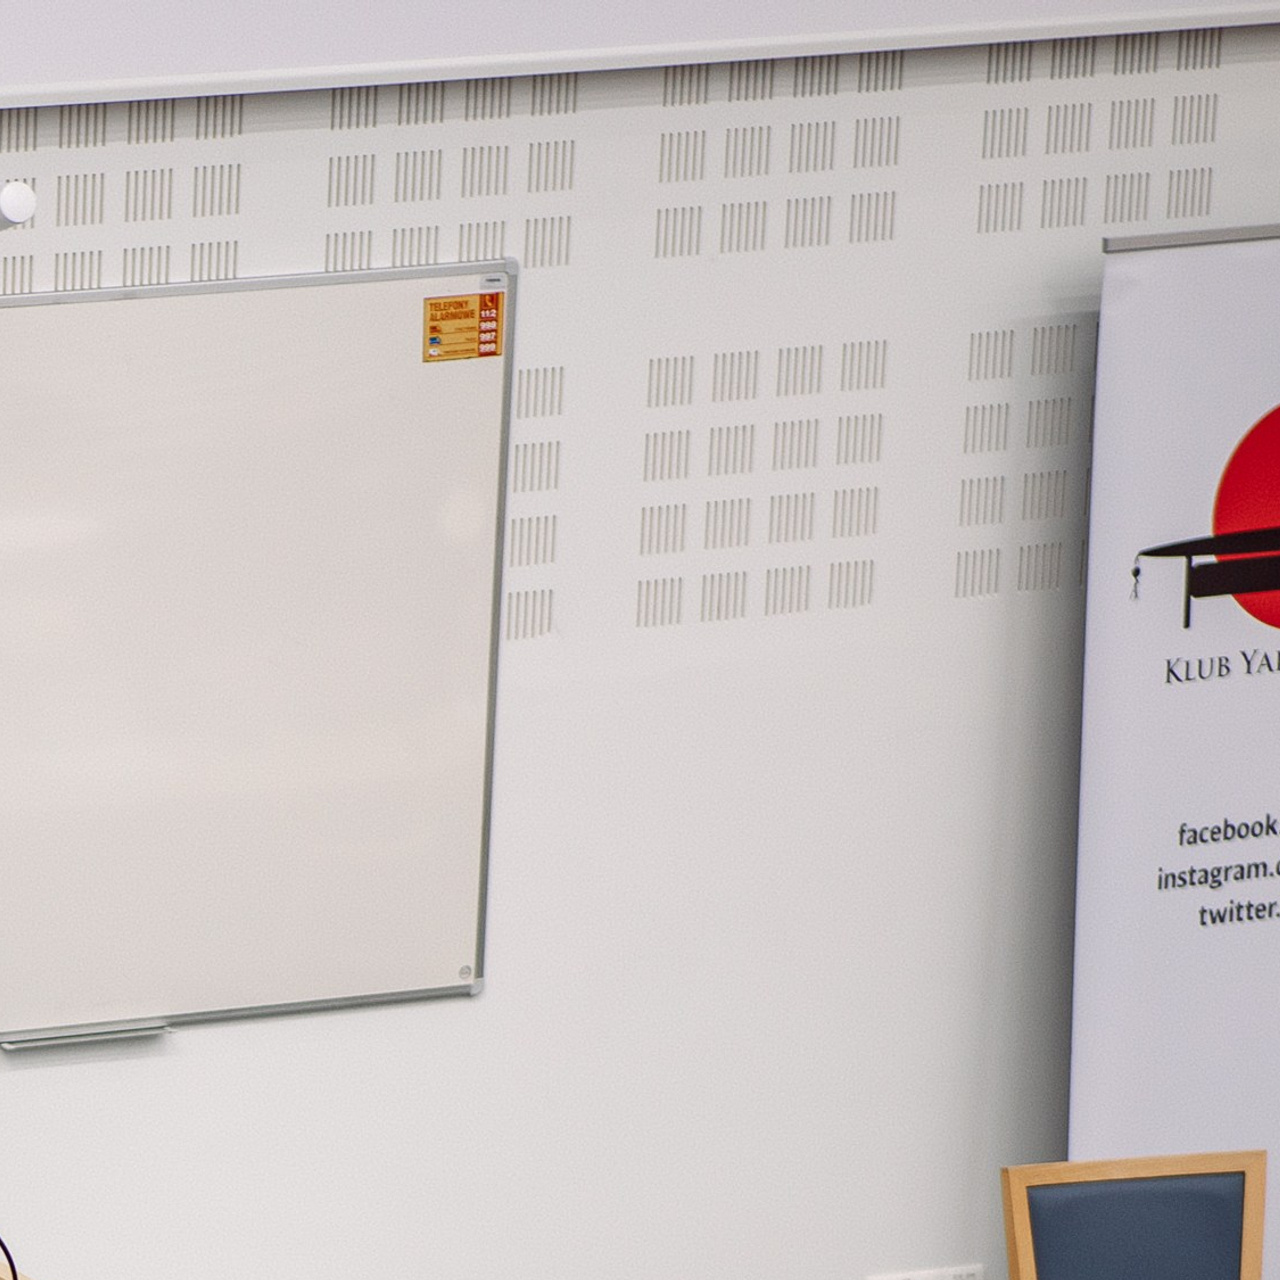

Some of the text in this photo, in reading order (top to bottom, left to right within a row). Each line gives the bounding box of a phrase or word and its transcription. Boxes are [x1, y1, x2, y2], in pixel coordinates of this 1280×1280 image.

[429, 300, 468, 312] TELEFONY
[429, 309, 476, 321] ALARMOWE
[480, 309, 497, 318] 112
[1178, 812, 1280, 846] facebook
